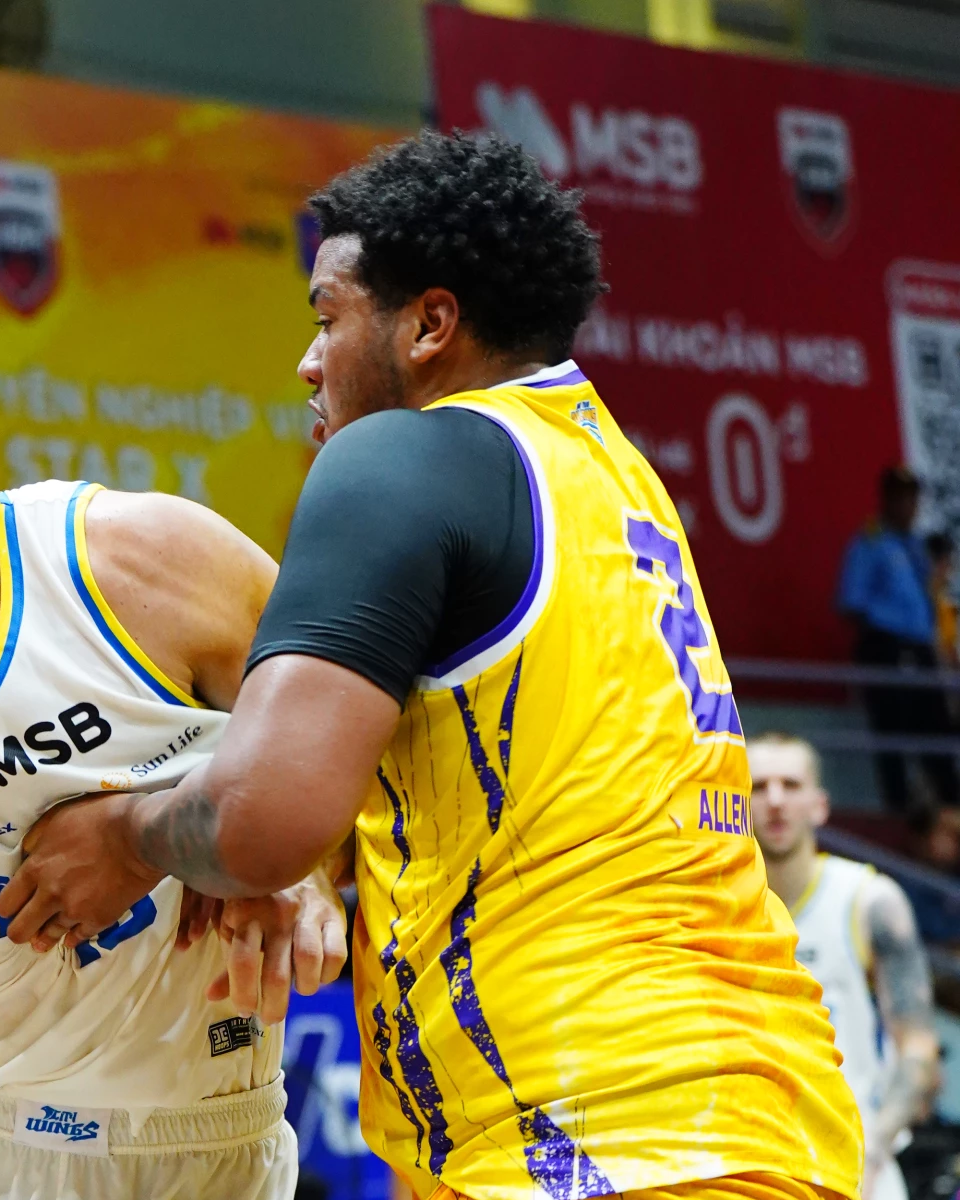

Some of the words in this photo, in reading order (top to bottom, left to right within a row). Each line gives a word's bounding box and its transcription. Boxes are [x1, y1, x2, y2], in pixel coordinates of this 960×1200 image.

[570, 103, 704, 193] MSB
[131, 752, 169, 777] Sun
[167, 725, 203, 756] Life
[25, 1117, 100, 1142] WINGS
